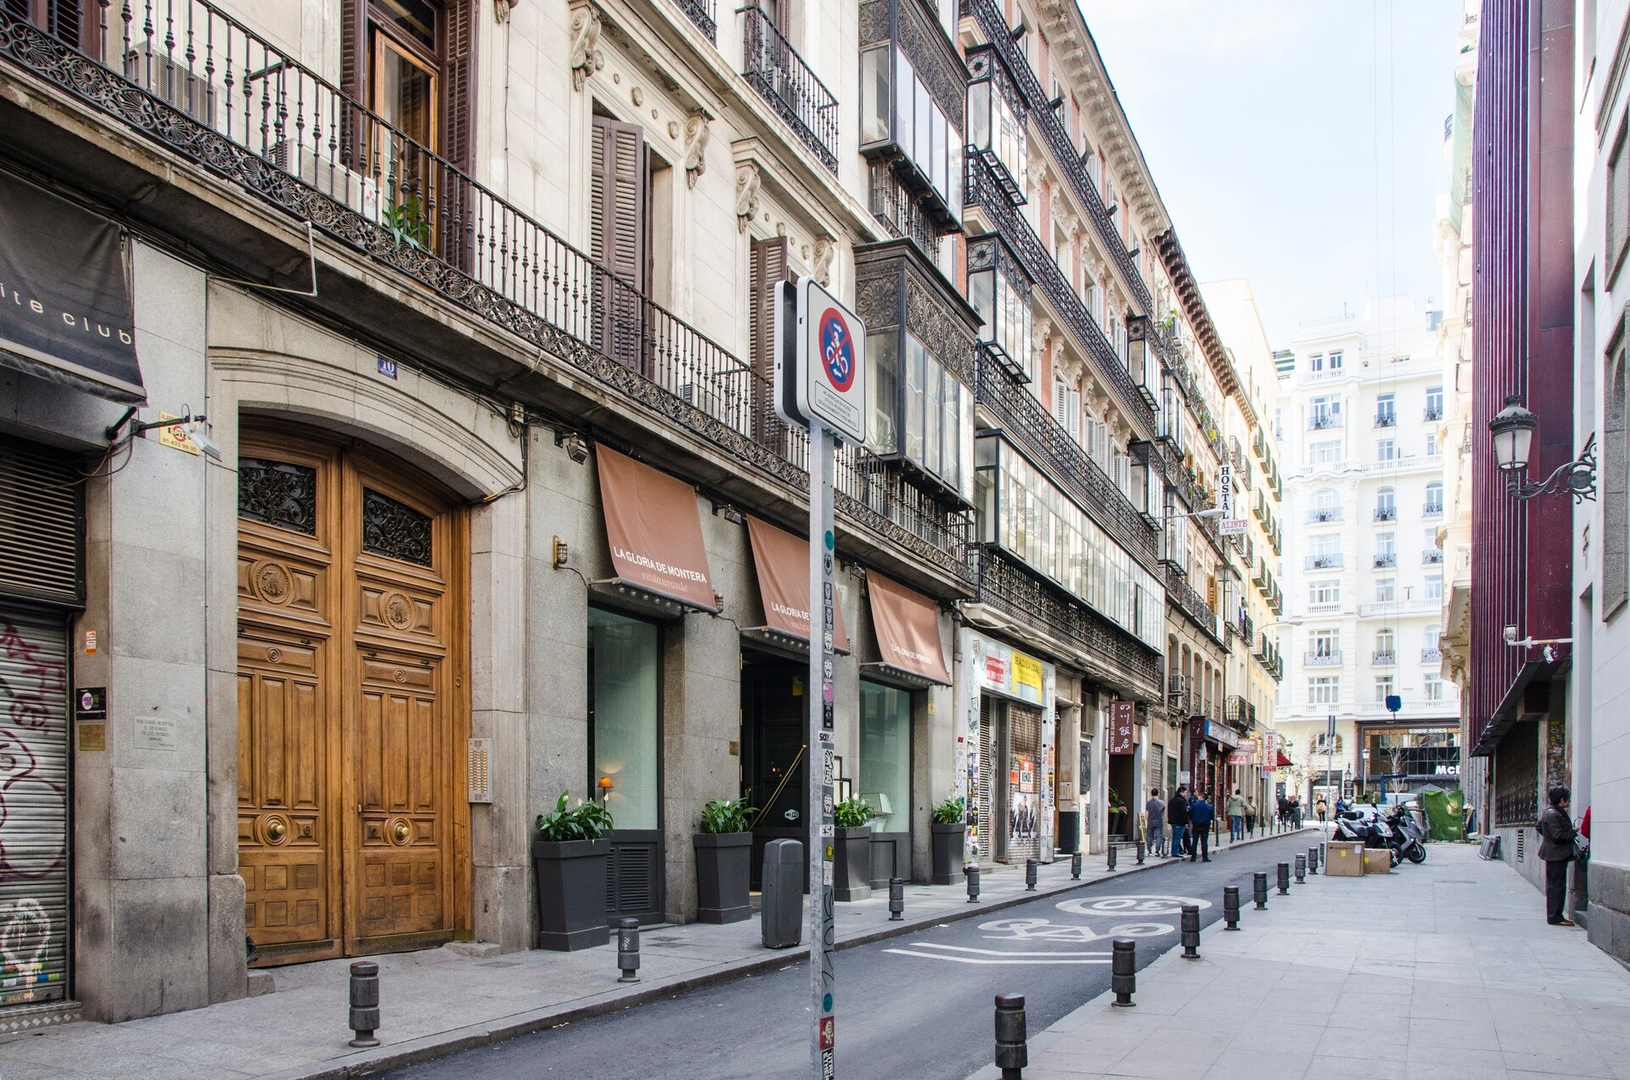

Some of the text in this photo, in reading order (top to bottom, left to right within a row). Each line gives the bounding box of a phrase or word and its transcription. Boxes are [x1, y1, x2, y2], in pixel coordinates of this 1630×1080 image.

[63, 312, 131, 344] club
[1221, 466, 1230, 520] HOSTAL
[1221, 520, 1248, 529] ALISTE
[613, 546, 708, 583] LA GLORIA DE MONTERA
[641, 572, 689, 592] restaurante
[771, 602, 810, 620] LA GLORIA DE
